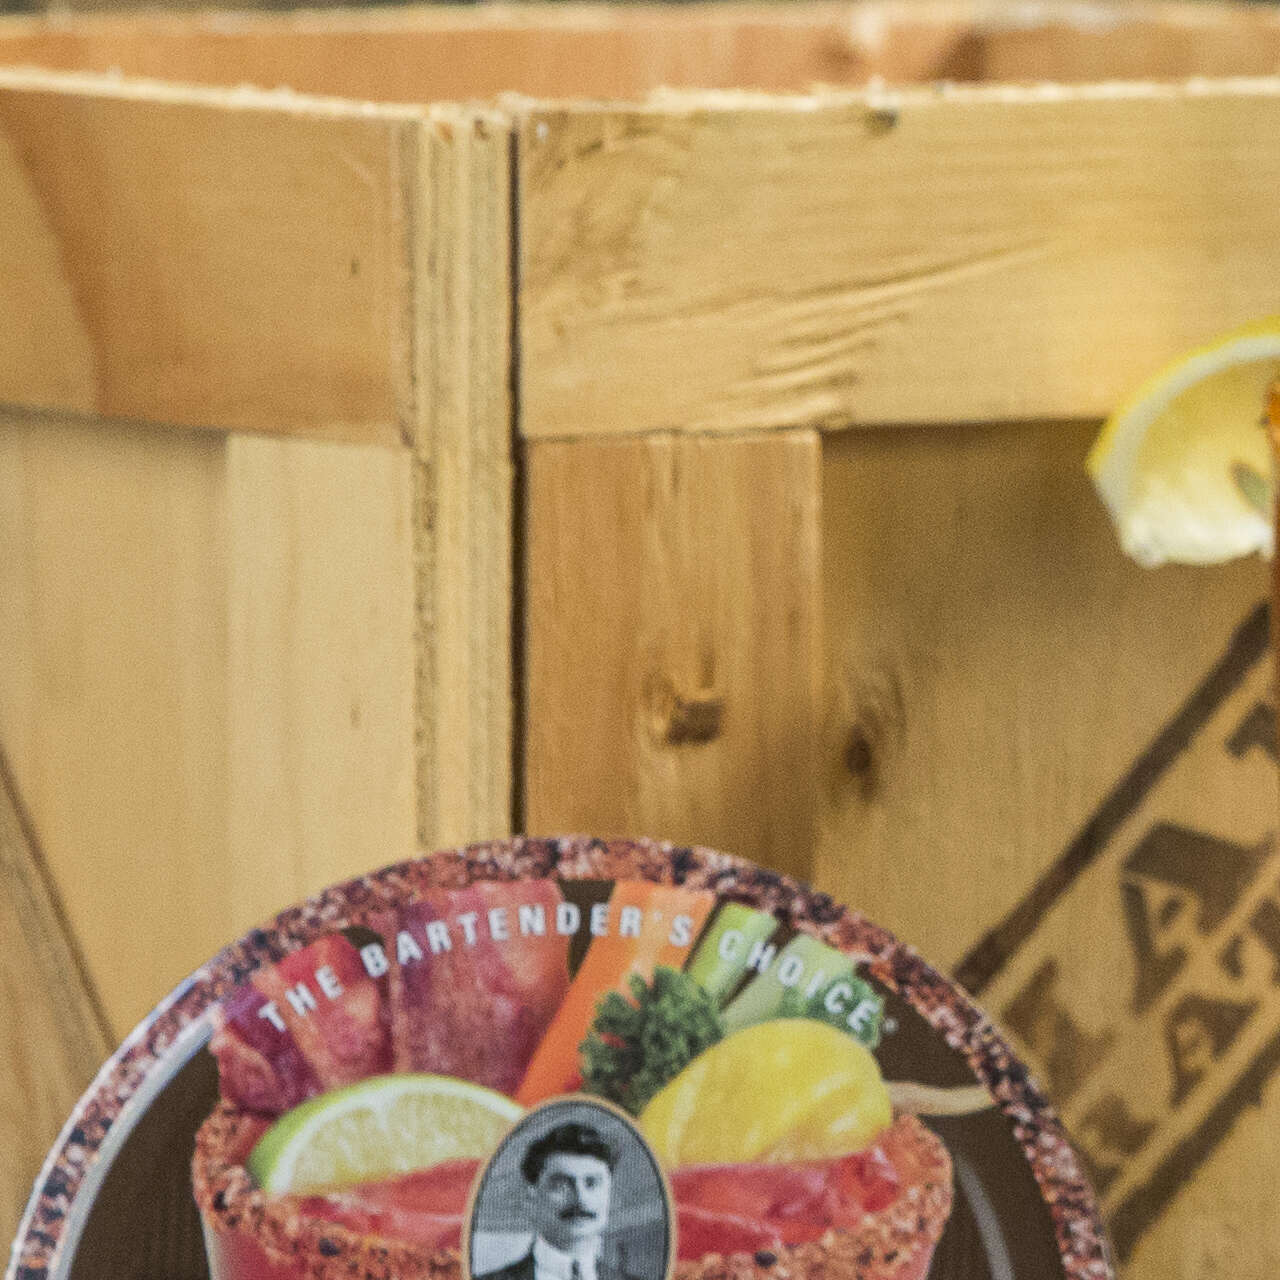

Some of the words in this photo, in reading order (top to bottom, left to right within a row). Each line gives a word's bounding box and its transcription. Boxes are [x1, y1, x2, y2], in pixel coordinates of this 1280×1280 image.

[258, 965, 344, 1033] THE
[360, 902, 692, 979] BARTENDER'S
[719, 929, 882, 1033] CHOICE
